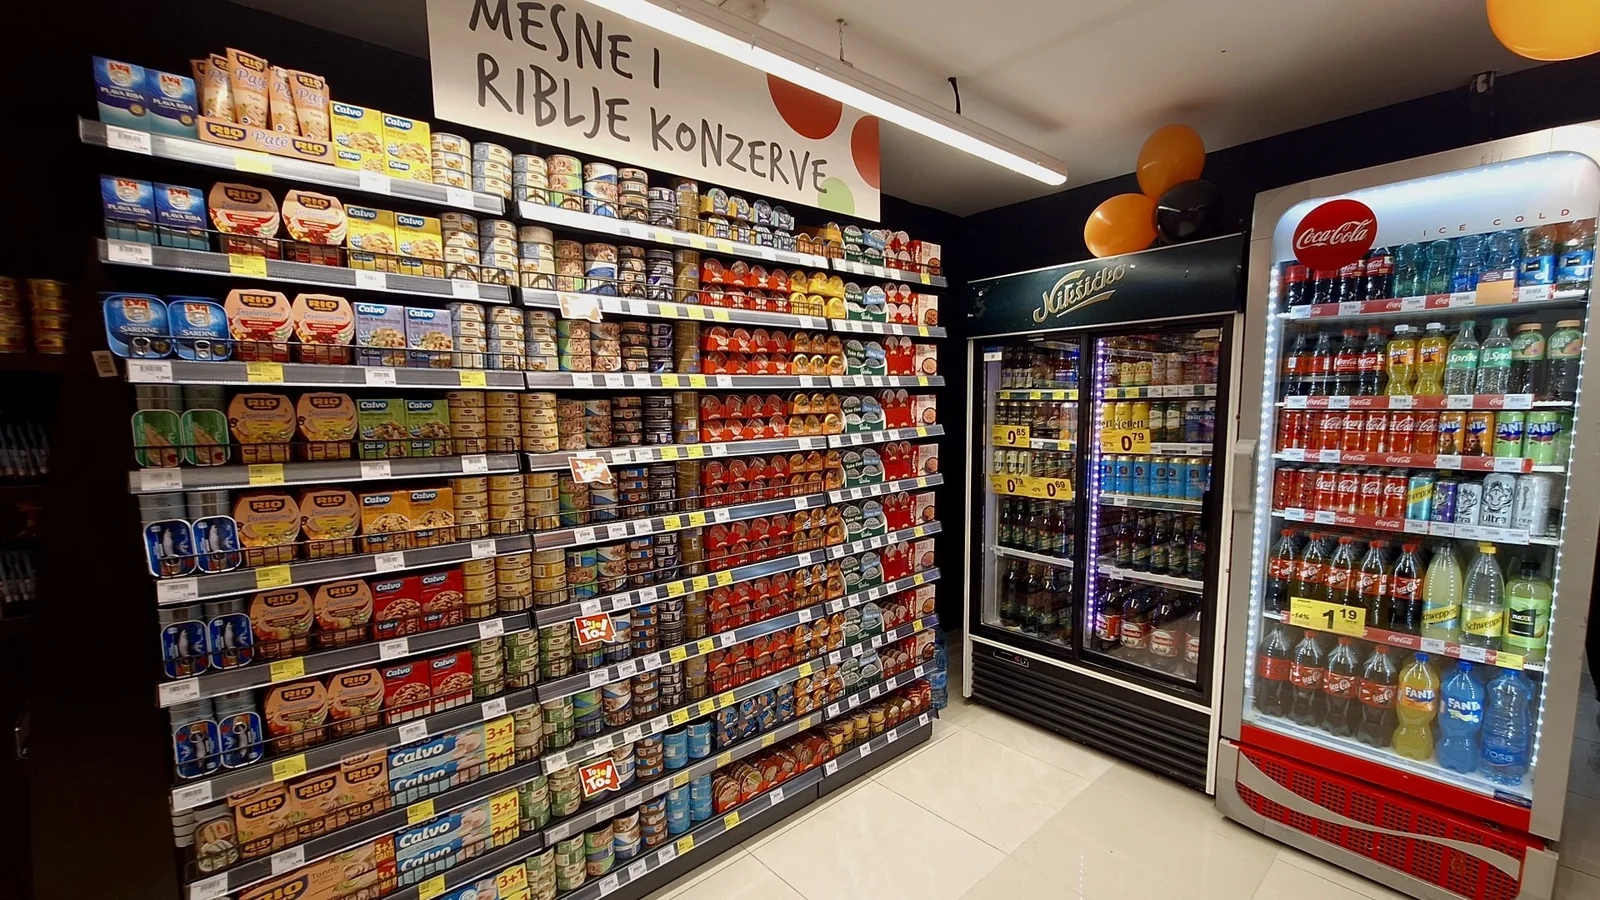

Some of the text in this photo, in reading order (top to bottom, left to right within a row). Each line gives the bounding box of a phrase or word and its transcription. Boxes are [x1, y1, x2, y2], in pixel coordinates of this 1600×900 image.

[469, 0, 661, 89] MESNE I
[239, 54, 263, 70] RIO
[300, 74, 322, 89] RIO
[334, 104, 362, 118] Calvo
[385, 116, 411, 129] Calvo
[477, 52, 828, 194] RIBLJE KONZERVE
[209, 124, 244, 139] RIO
[251, 131, 289, 149] Paté
[294, 141, 325, 154] RIO
[339, 151, 360, 161] Calvo
[389, 160, 409, 170] Calvo
[227, 188, 259, 199] RIO
[302, 196, 330, 207] RIO
[348, 208, 375, 219] Calvo
[398, 216, 423, 227] Calvo
[1296, 218, 1374, 251] Coca-Cola
[1032, 263, 1127, 324] Nikšićko
[123, 298, 149, 309] EVA
[242, 295, 274, 304] RIO
[308, 300, 338, 309] RIO
[185, 303, 209, 313] EVA
[358, 305, 385, 314] Calvo
[409, 309, 434, 318] Calvo
[120, 325, 159, 335] SARDINE
[182, 328, 219, 338] SARDINE
[1450, 353, 1478, 363] Sprite
[1489, 351, 1512, 361] Spri
[248, 398, 277, 407] RIO
[313, 397, 341, 406] RIO
[361, 401, 387, 410] Calvo
[408, 401, 433, 410] Calvo
[1439, 421, 1461, 431] ANTA
[1496, 421, 1524, 433] FANT
[1016, 428, 1026, 437] 85
[1120, 432, 1145, 452] 0 79
[1343, 454, 1367, 462] Coca-Cola
[1386, 455, 1412, 463] Coca-Cola
[1007, 477, 1024, 493] 0 79
[1046, 480, 1066, 497] 0 69
[315, 496, 343, 504] RIO
[364, 495, 390, 504] Calvo
[412, 492, 437, 500] Calvo
[252, 501, 283, 510] RIO
[1375, 519, 1400, 528] Coca-Cola
[1482, 513, 1507, 525] ultra
[423, 574, 446, 584] Calvo
[330, 586, 357, 595] RIO
[376, 582, 401, 591] Calvo
[267, 594, 296, 604] RIO
[1292, 611, 1310, 621] -14%
[1322, 608, 1358, 630] 1 19
[1465, 616, 1504, 631] Schweppe
[1388, 634, 1414, 645] Coca-Cola
[433, 657, 456, 668] Calvo
[386, 667, 411, 677] Calvo
[343, 675, 370, 685] RIO
[284, 688, 312, 698] RIO
[1405, 687, 1435, 700] FANTA
[1448, 698, 1481, 711] FANTA
[486, 723, 513, 740] 3+1
[393, 743, 444, 767] Calvo
[1485, 749, 1513, 762] rosa
[348, 764, 381, 781] RIO
[354, 774, 375, 783] mare
[395, 769, 445, 791] Calvo
[299, 780, 333, 797] RIO
[305, 790, 327, 800] mare
[245, 797, 282, 814] RIO
[491, 796, 517, 813] 3+1
[252, 807, 277, 817] mare
[400, 822, 450, 846] Calvo
[376, 840, 393, 852] 3+1
[375, 848, 394, 862] GRATIS
[311, 865, 339, 879] Tonno
[498, 867, 524, 888] 3+1
